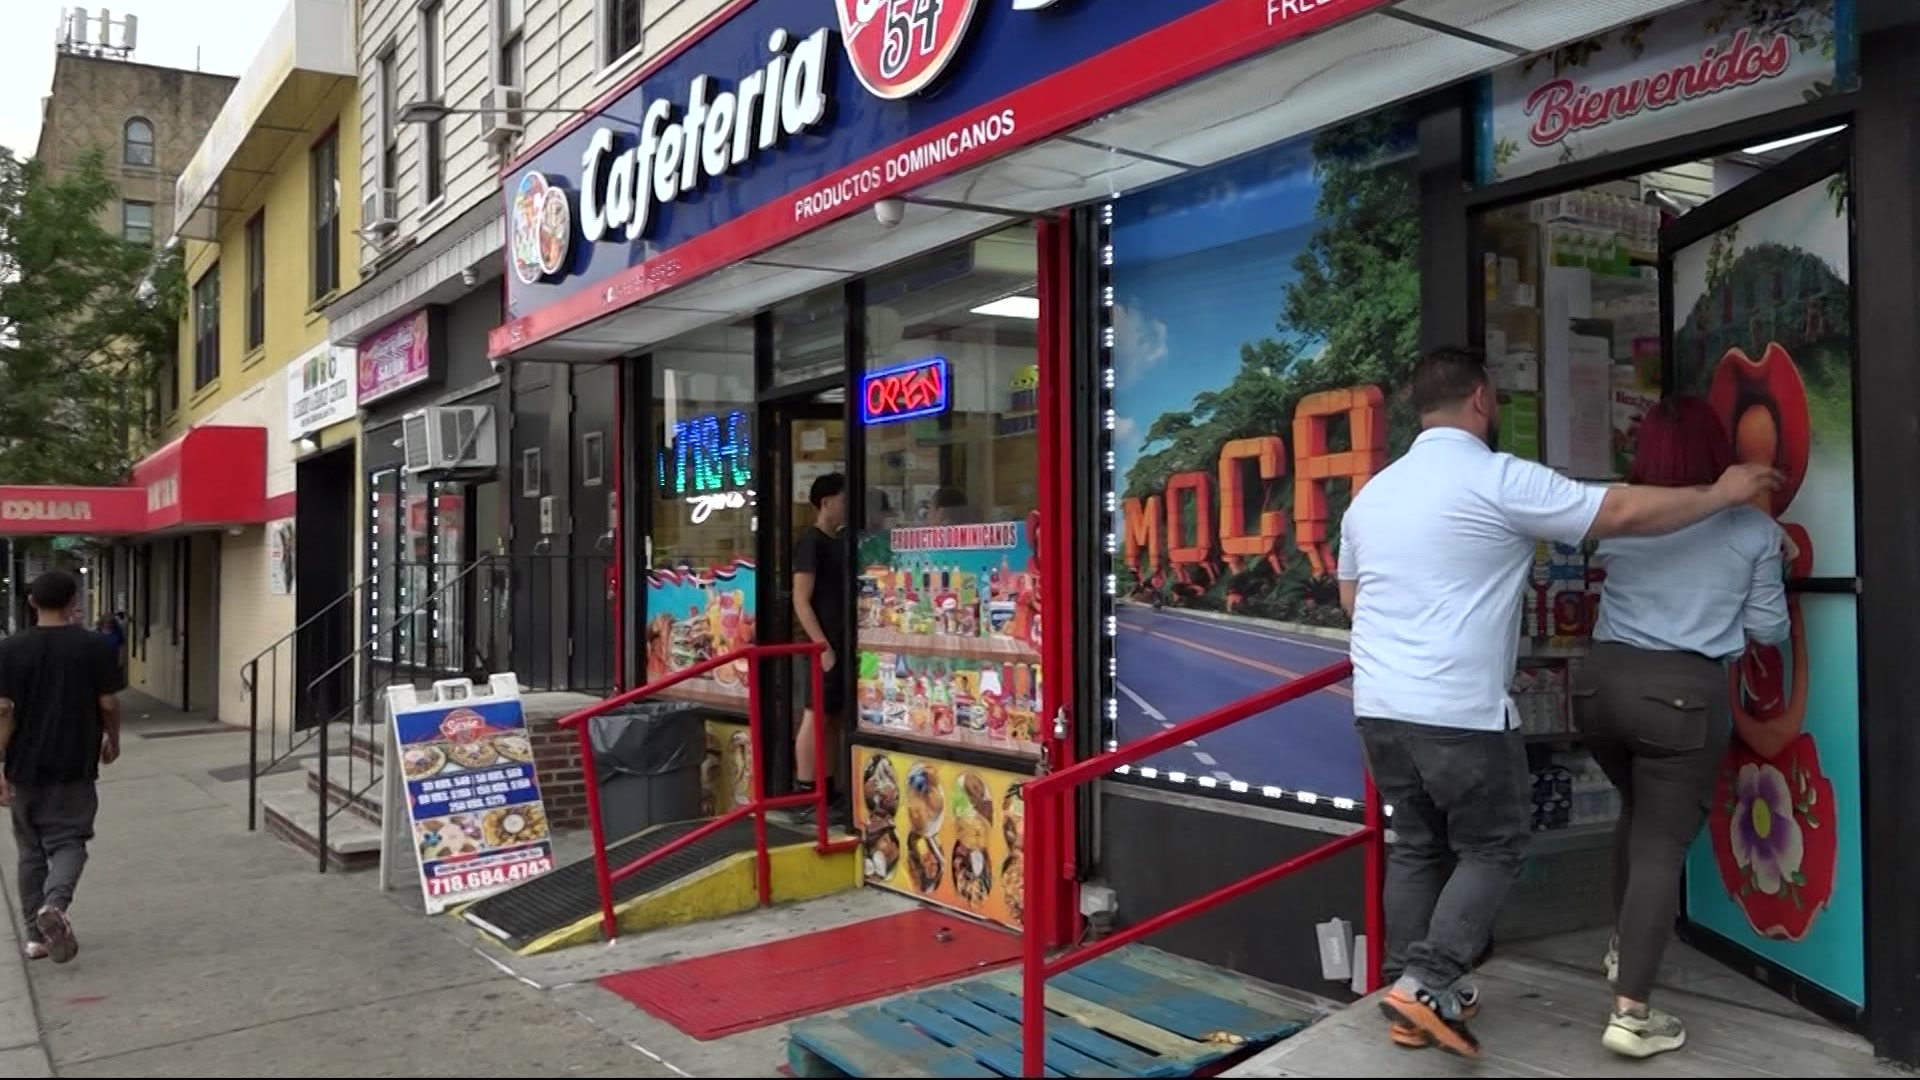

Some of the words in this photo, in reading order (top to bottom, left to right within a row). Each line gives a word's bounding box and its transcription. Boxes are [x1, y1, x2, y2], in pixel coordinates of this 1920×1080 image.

[880, 0, 941, 78] 54
[1267, 0, 1330, 26] FR
[1525, 29, 1788, 144] Bienvenidos
[580, 28, 827, 241] Cafeteria
[794, 166, 881, 223] PRODUCTOS
[885, 109, 1016, 183] DOMINICANOS
[867, 365, 942, 414] OPEN
[1123, 384, 1385, 568] MOCA
[891, 526, 945, 550] PRODUCTOS
[946, 522, 1017, 550] DOMINICANOS
[429, 858, 552, 896] 718.684.4743
